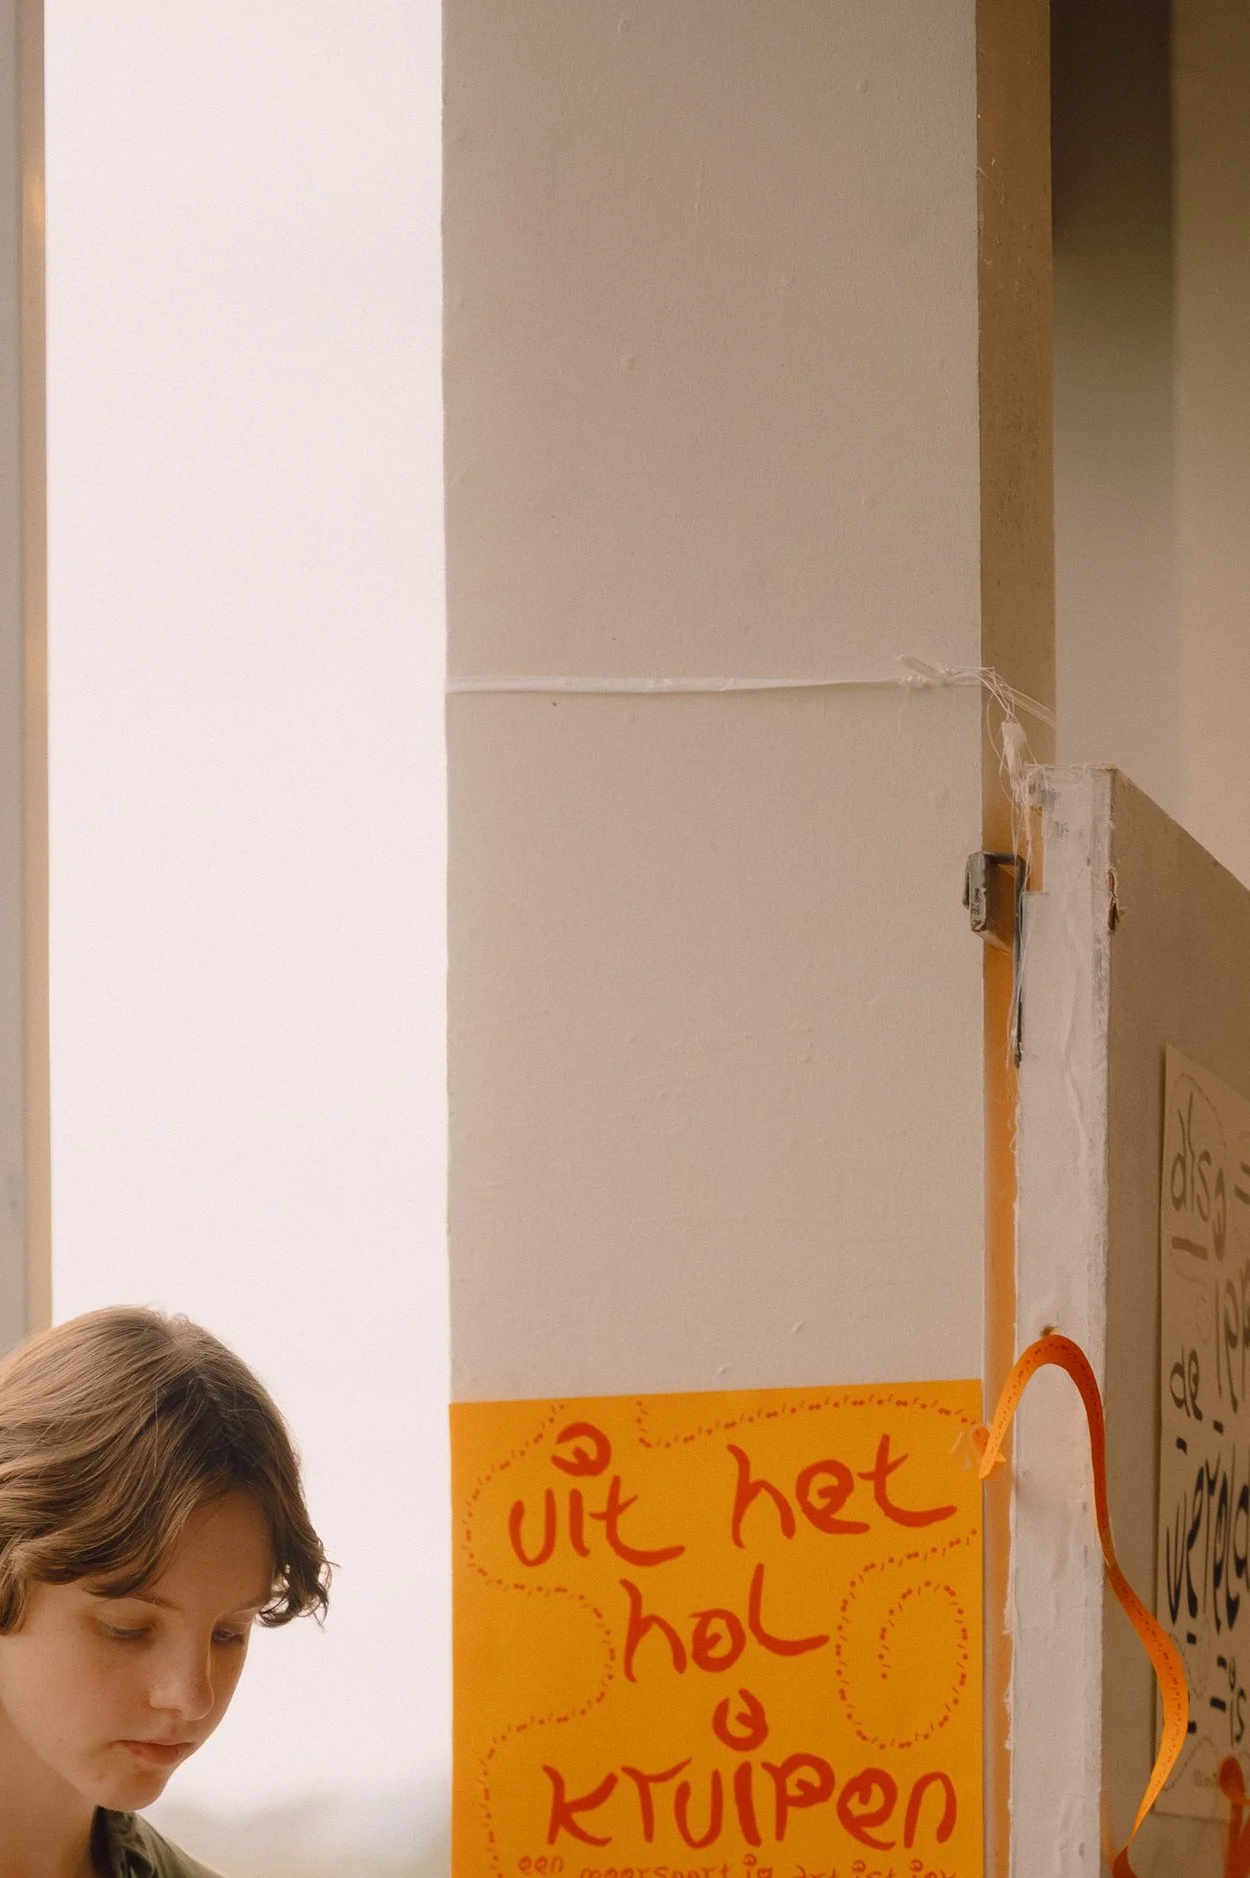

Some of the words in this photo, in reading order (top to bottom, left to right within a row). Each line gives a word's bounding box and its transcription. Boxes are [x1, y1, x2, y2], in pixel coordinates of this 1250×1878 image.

[509, 1422, 686, 1567] uit
[726, 1433, 958, 1549] het
[619, 1562, 830, 1682] hol
[542, 1689, 958, 1850] kruipen
[517, 1854, 564, 1876] een
